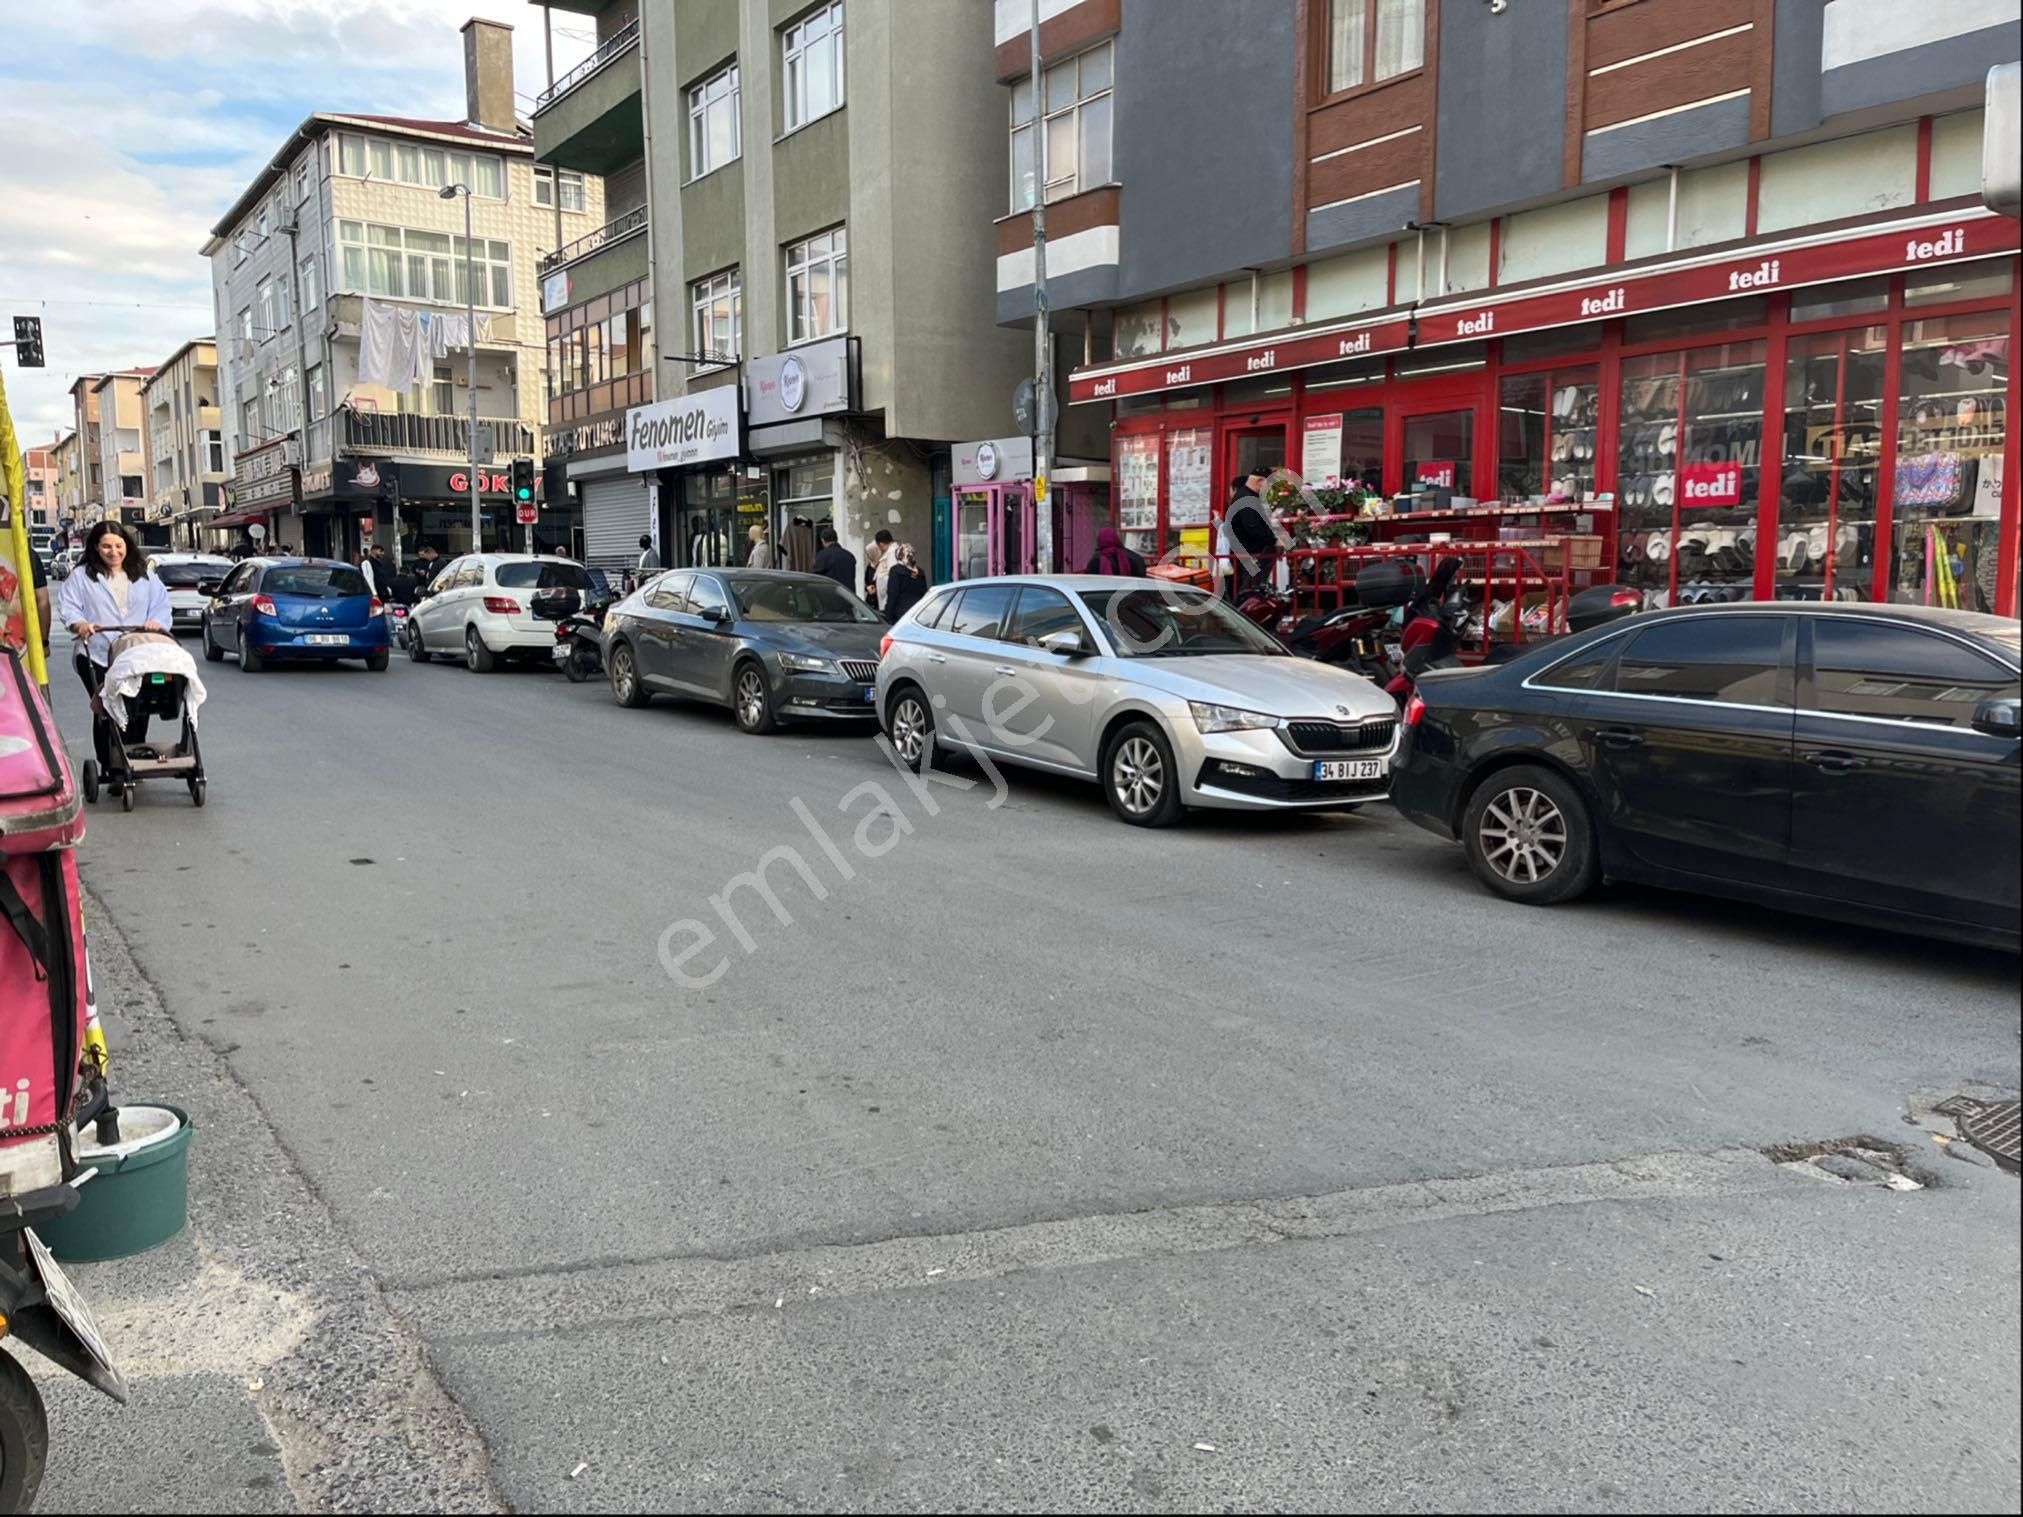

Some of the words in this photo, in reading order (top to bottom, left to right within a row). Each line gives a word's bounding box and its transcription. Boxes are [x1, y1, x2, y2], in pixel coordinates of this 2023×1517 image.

[1905, 228, 1965, 261] tedi
[1728, 260, 1780, 291] tedi
[1580, 288, 1625, 316] tedi
[1456, 311, 1495, 336] tedi
[1339, 333, 1371, 355] tedi
[1247, 350, 1276, 371] tedi
[1094, 378, 1116, 396] tedi
[1166, 365, 1191, 385] tedi
[631, 409, 705, 451] Fenomen
[706, 418, 729, 442] Giyim
[450, 469, 543, 493] GÖKY
[1685, 471, 1736, 498] tedi
[518, 509, 536, 518] DUR
[1321, 763, 1334, 778] 34
[1338, 763, 1358, 777] BIJ
[1361, 762, 1379, 777] 237
